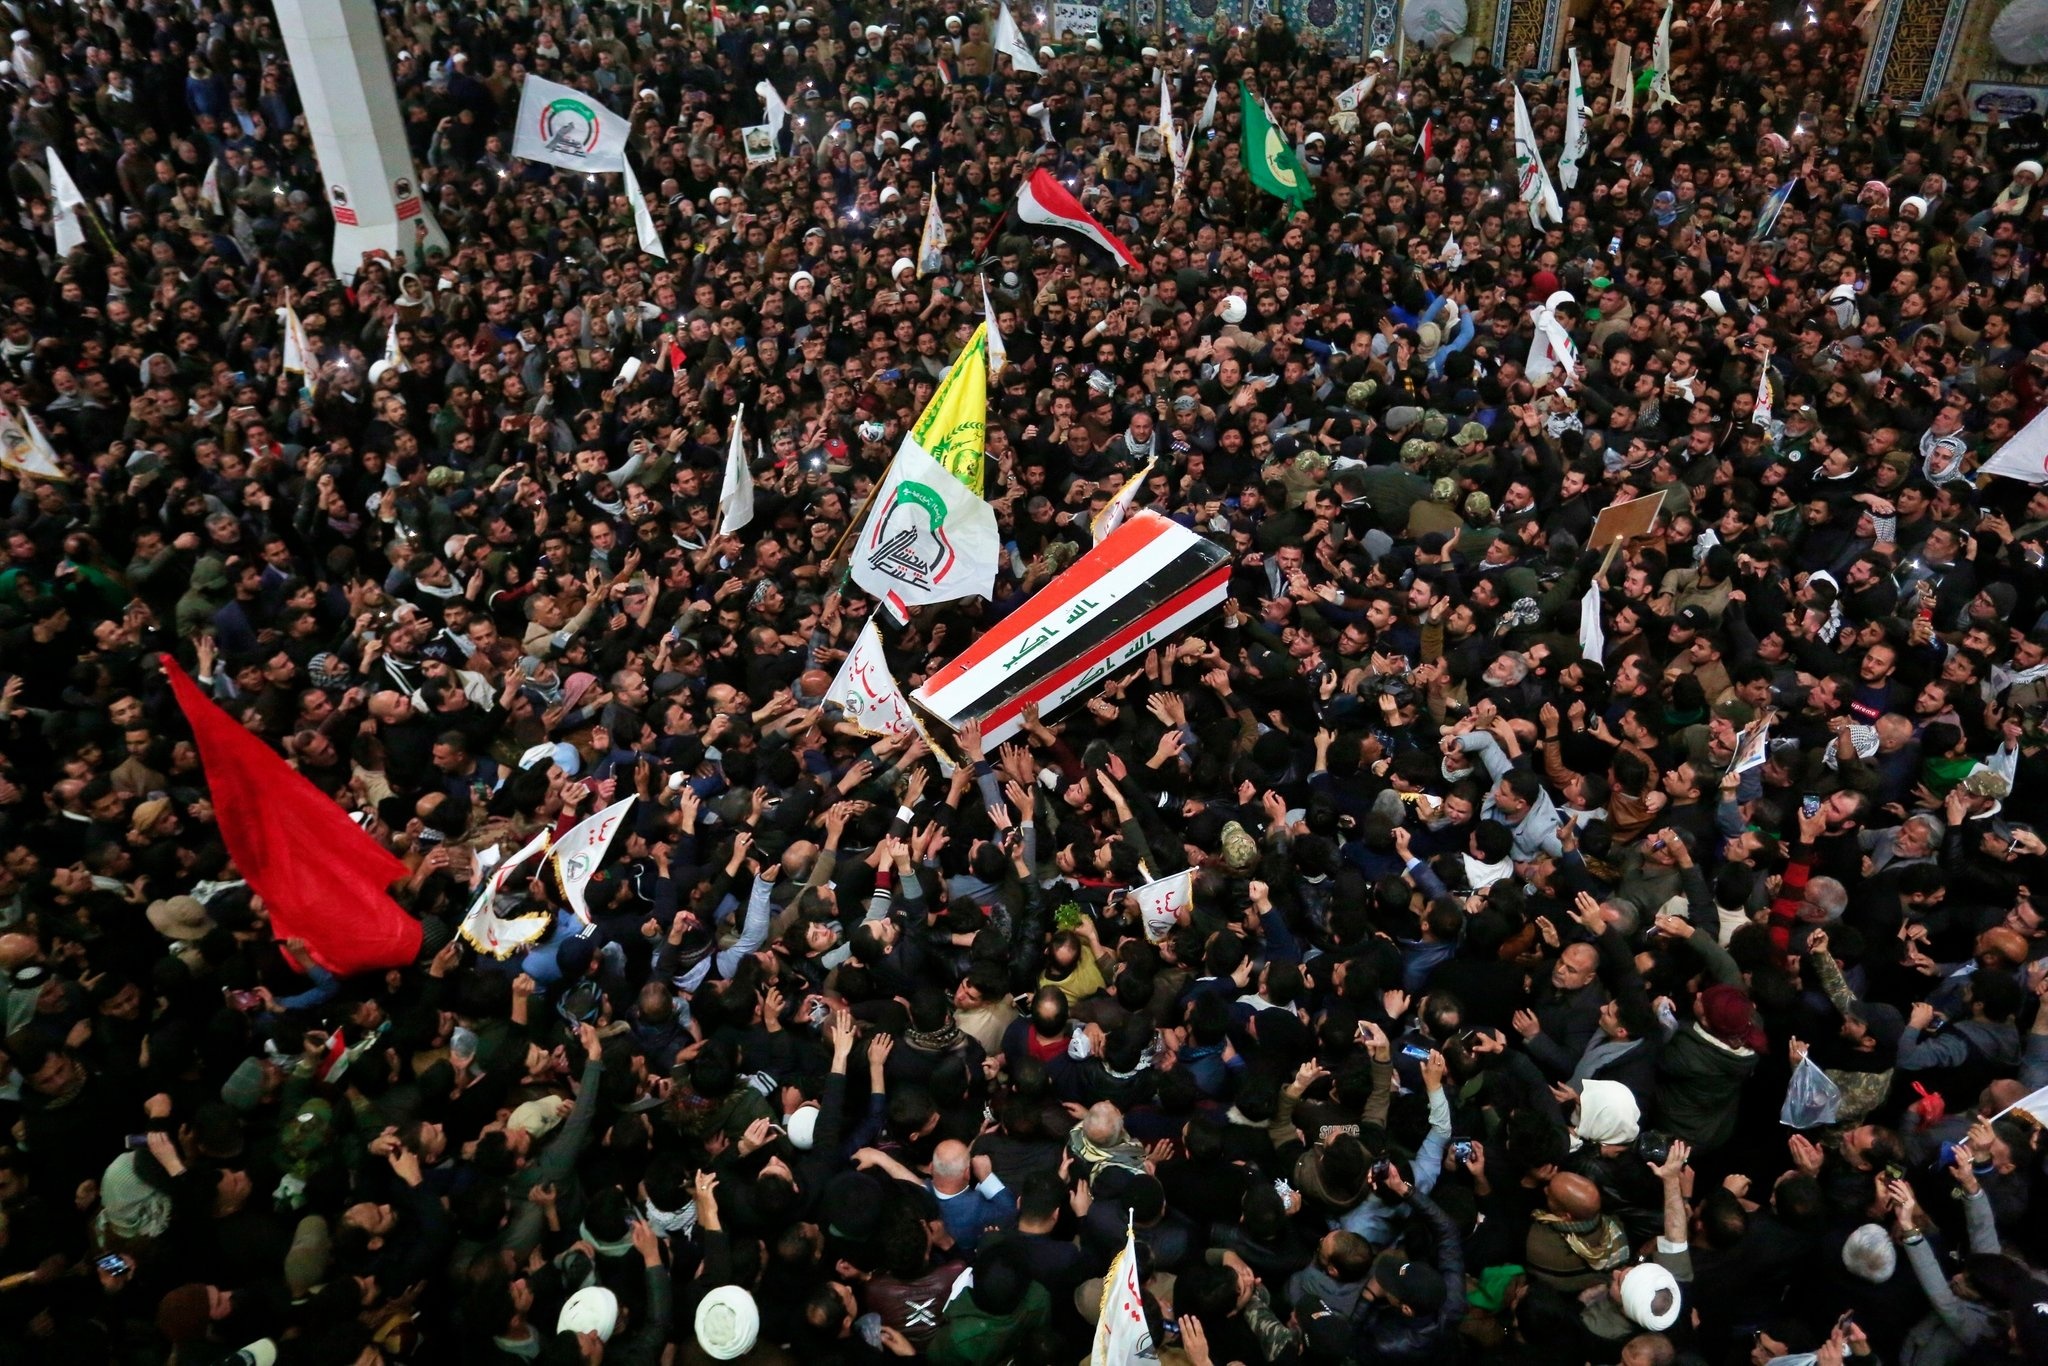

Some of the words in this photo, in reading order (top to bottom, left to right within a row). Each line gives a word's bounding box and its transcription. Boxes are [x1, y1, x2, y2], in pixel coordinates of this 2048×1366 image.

[1066, 599, 1099, 625] الله
[1124, 632, 1156, 660] الله
[1851, 702, 1876, 716] upreme
